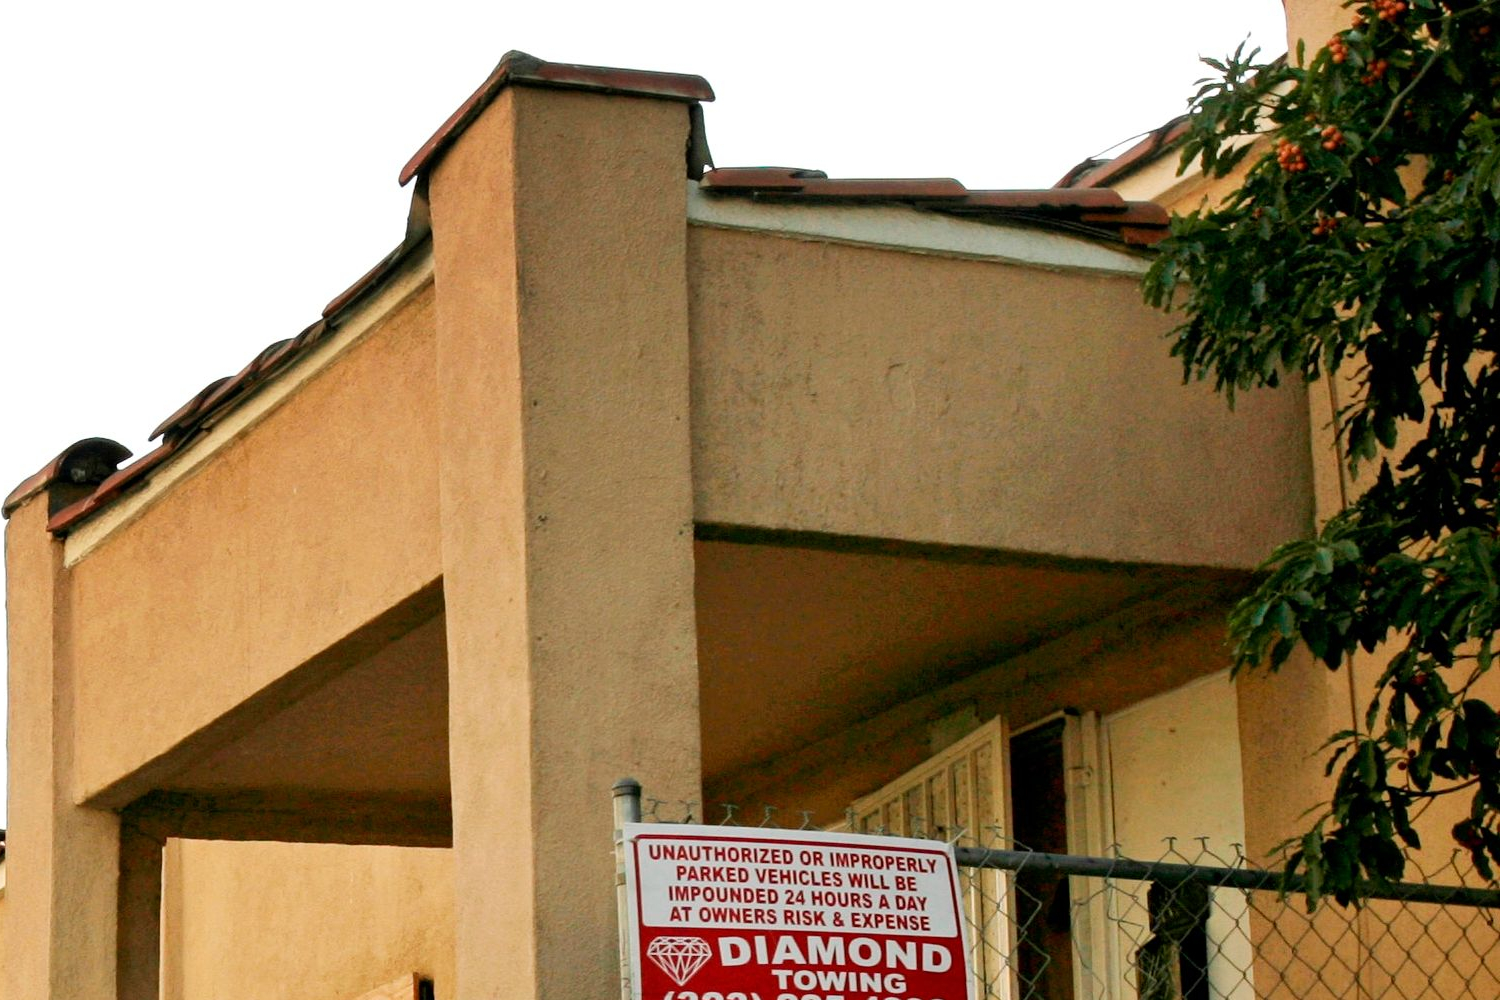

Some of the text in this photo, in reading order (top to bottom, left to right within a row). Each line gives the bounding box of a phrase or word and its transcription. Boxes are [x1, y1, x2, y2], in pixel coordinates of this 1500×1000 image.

[649, 845, 936, 873] UNAUTHORIZED OR IMPROPERLY
[677, 866, 917, 891] PARKED VEHICLES WILL BE
[668, 886, 927, 911] IMPOUNDED 24 HOURS A DAY
[670, 907, 930, 931] AT OWNERS RISK & EXPENSE
[718, 936, 952, 972] DIAMOND
[771, 969, 907, 993] TOWING
